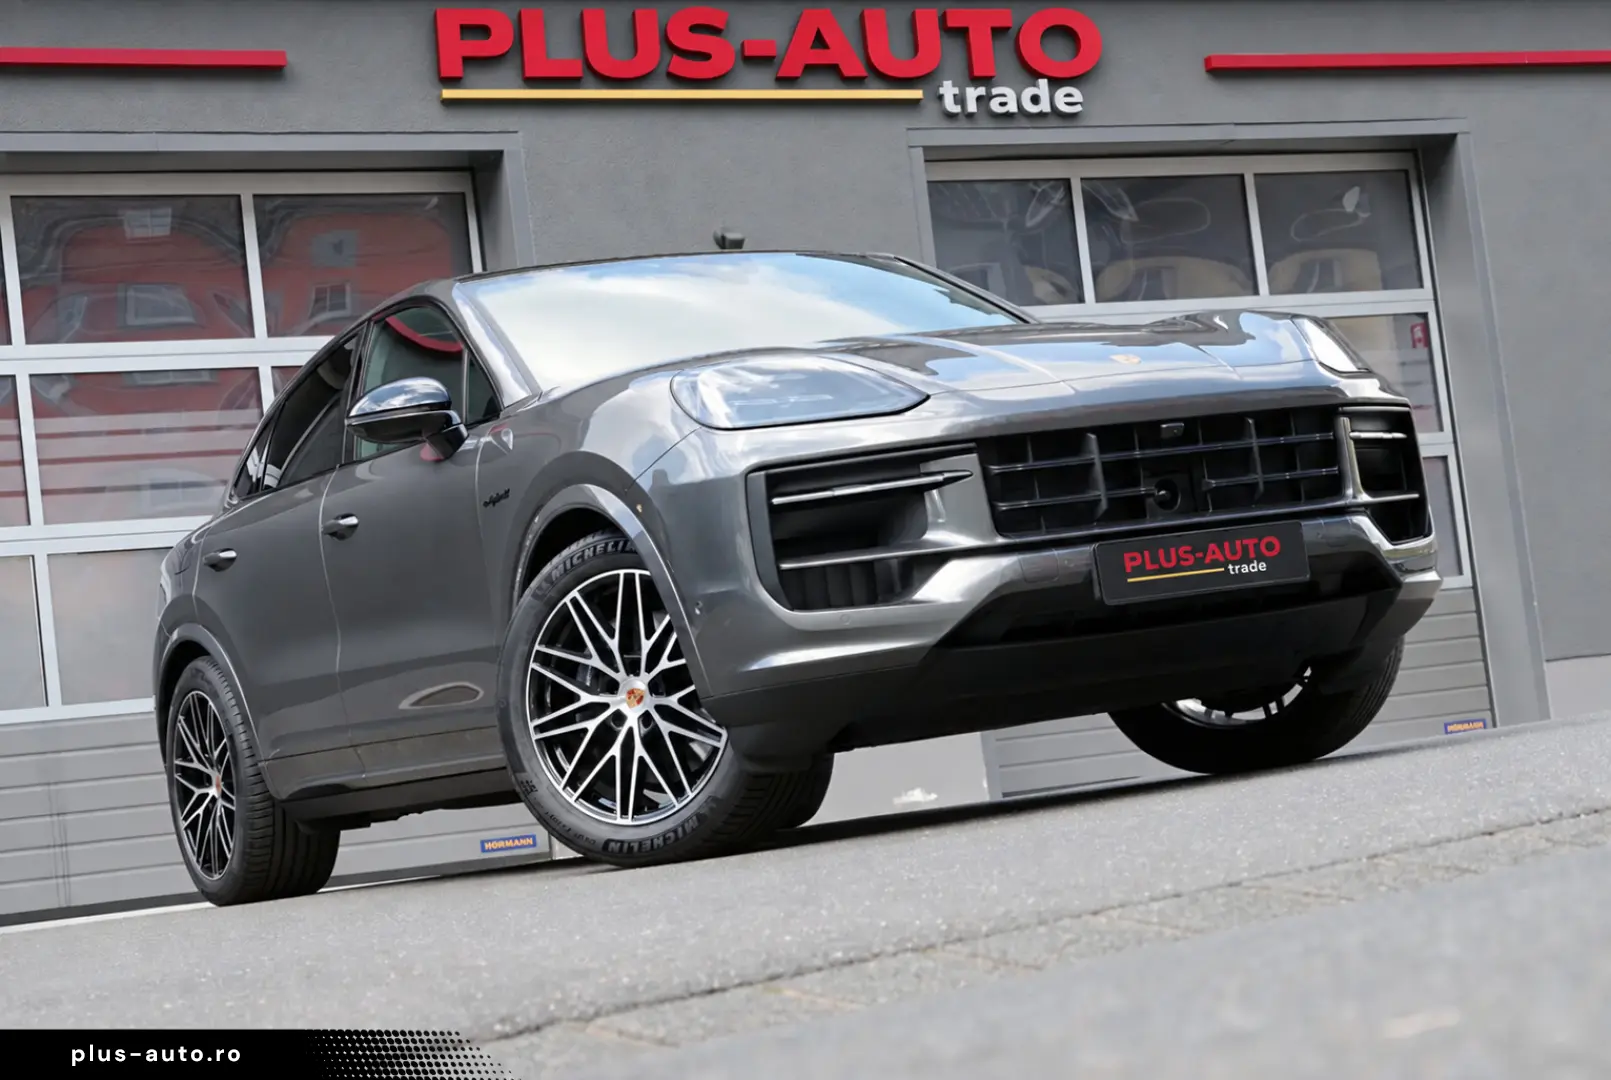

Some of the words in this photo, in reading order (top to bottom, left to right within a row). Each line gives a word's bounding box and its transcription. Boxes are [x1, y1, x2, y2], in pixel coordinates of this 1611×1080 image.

[434, 6, 1103, 80] PLUS-AUTO
[938, 78, 1084, 114] trade
[1123, 535, 1281, 573] PLUS-AUTO
[1227, 560, 1267, 575] trade
[607, 815, 699, 853] MICHELIN
